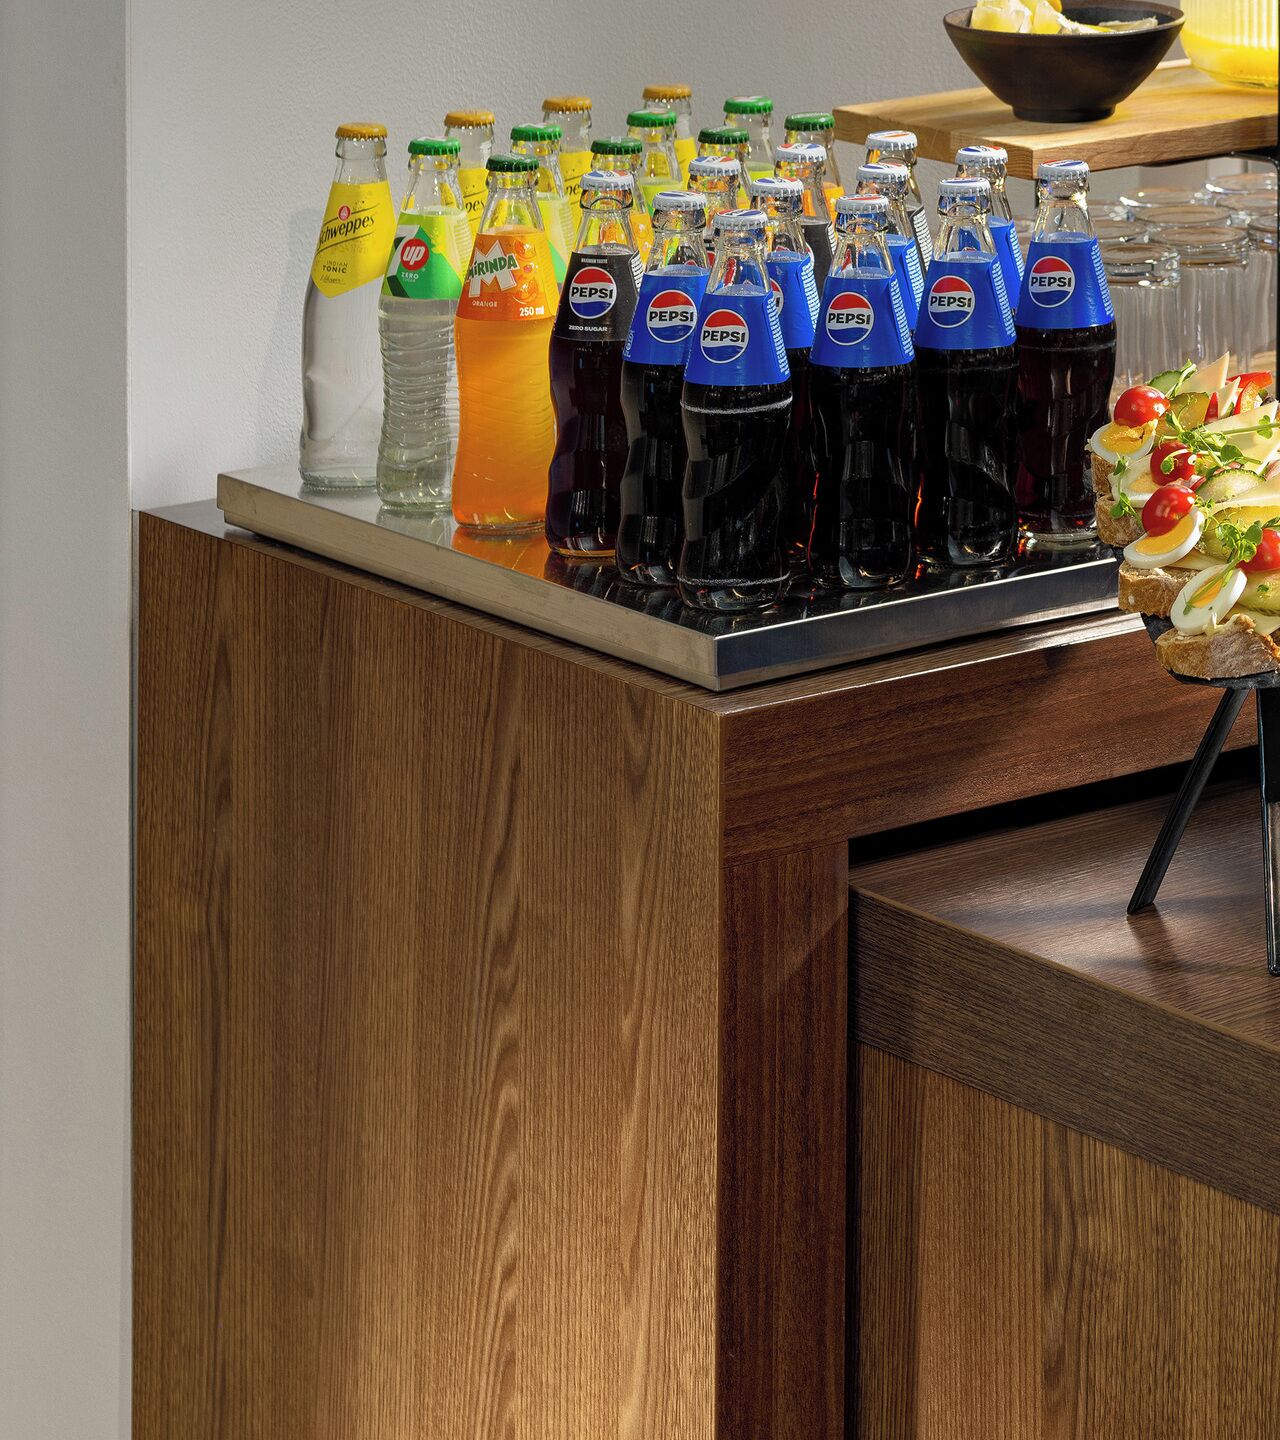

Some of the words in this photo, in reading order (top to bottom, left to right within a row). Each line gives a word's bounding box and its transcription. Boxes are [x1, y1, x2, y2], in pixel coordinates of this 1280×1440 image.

[322, 265, 347, 274] TONIC
[401, 271, 419, 280] ZERO
[1030, 276, 1072, 288] PEPSI
[571, 286, 614, 300] PEPSI
[471, 300, 498, 308] ORANGE
[930, 295, 972, 308] PEPSI
[519, 307, 534, 317] 250
[535, 305, 545, 315] ml
[649, 310, 694, 322] PEPSI
[827, 312, 871, 325] PEPSI
[568, 324, 584, 332] ZERO
[702, 330, 746, 343] PEPSI
